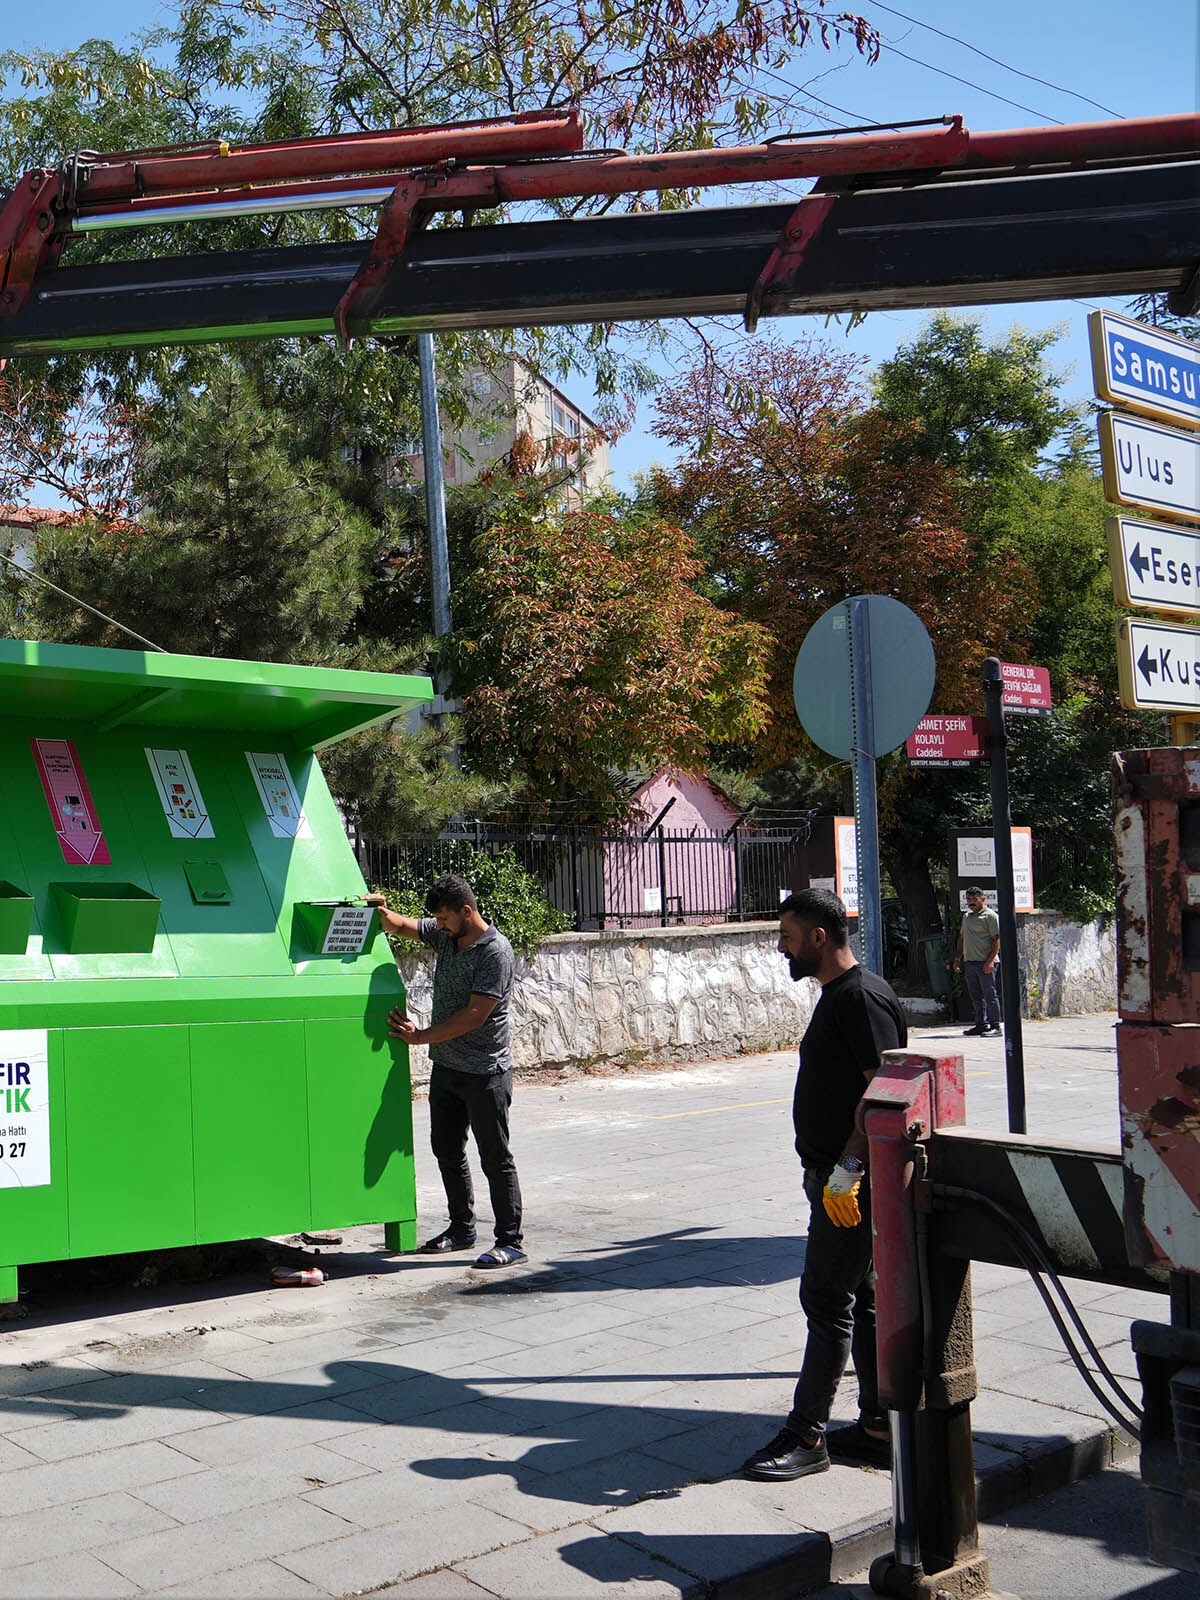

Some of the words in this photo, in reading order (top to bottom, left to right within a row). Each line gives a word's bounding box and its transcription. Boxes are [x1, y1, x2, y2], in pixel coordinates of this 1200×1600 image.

[1113, 341, 1200, 400] Samsu
[1118, 438, 1174, 486] Ulus
[1003, 665, 1026, 679] GENERAL
[1026, 668, 1036, 680] DR.
[1003, 679, 1021, 692] TEVFİK
[1021, 680, 1042, 694] SAĞLAM
[1004, 694, 1022, 704] Caddesi
[945, 717, 967, 732] ŞEFİK
[915, 734, 945, 745] KOLAYLI
[916, 748, 943, 757] Caddesi
[843, 886, 858, 894] ANAD
[848, 897, 859, 907] LİS
[8, 1125, 27, 1136] Hattı
[9, 1142, 26, 1158] 27
